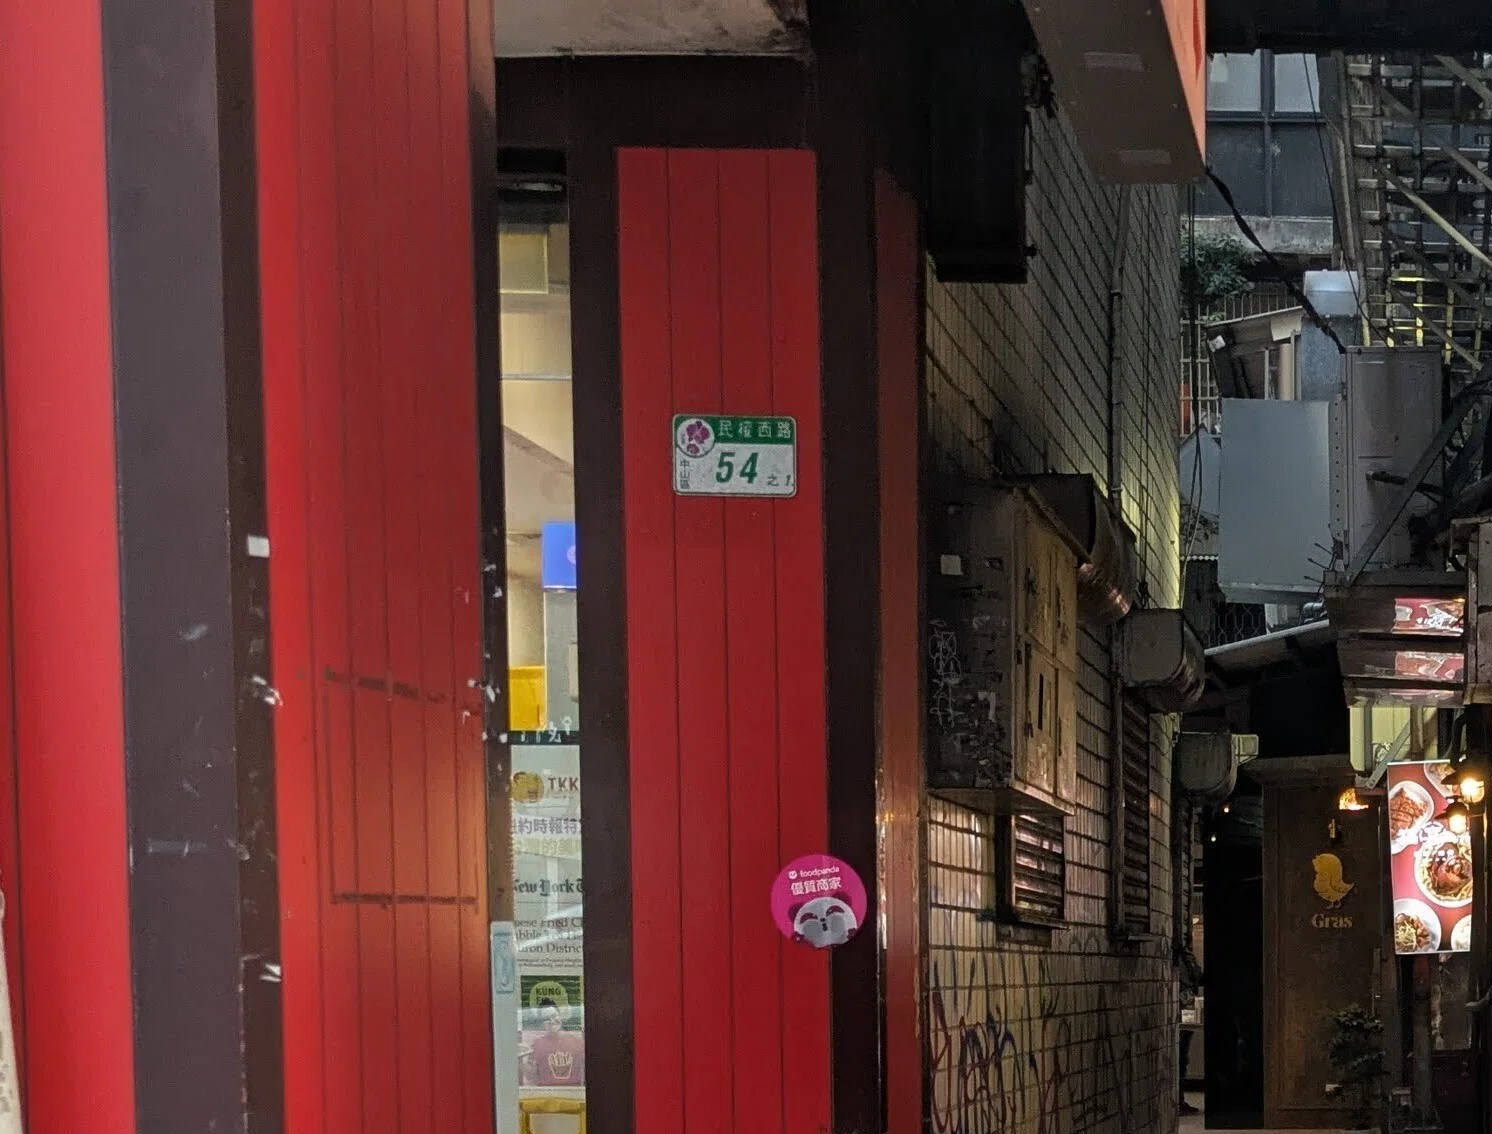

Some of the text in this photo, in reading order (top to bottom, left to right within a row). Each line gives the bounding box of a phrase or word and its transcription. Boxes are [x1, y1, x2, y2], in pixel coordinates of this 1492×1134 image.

[717, 420, 791, 438] 民權西路
[679, 459, 690, 490] 中山區
[715, 451, 759, 484] 54
[547, 777, 579, 791] TKK
[514, 817, 582, 835] 約時報特
[799, 866, 840, 878] foodpanda
[790, 876, 842, 896] 優質商家
[1311, 913, 1353, 929] Gras
